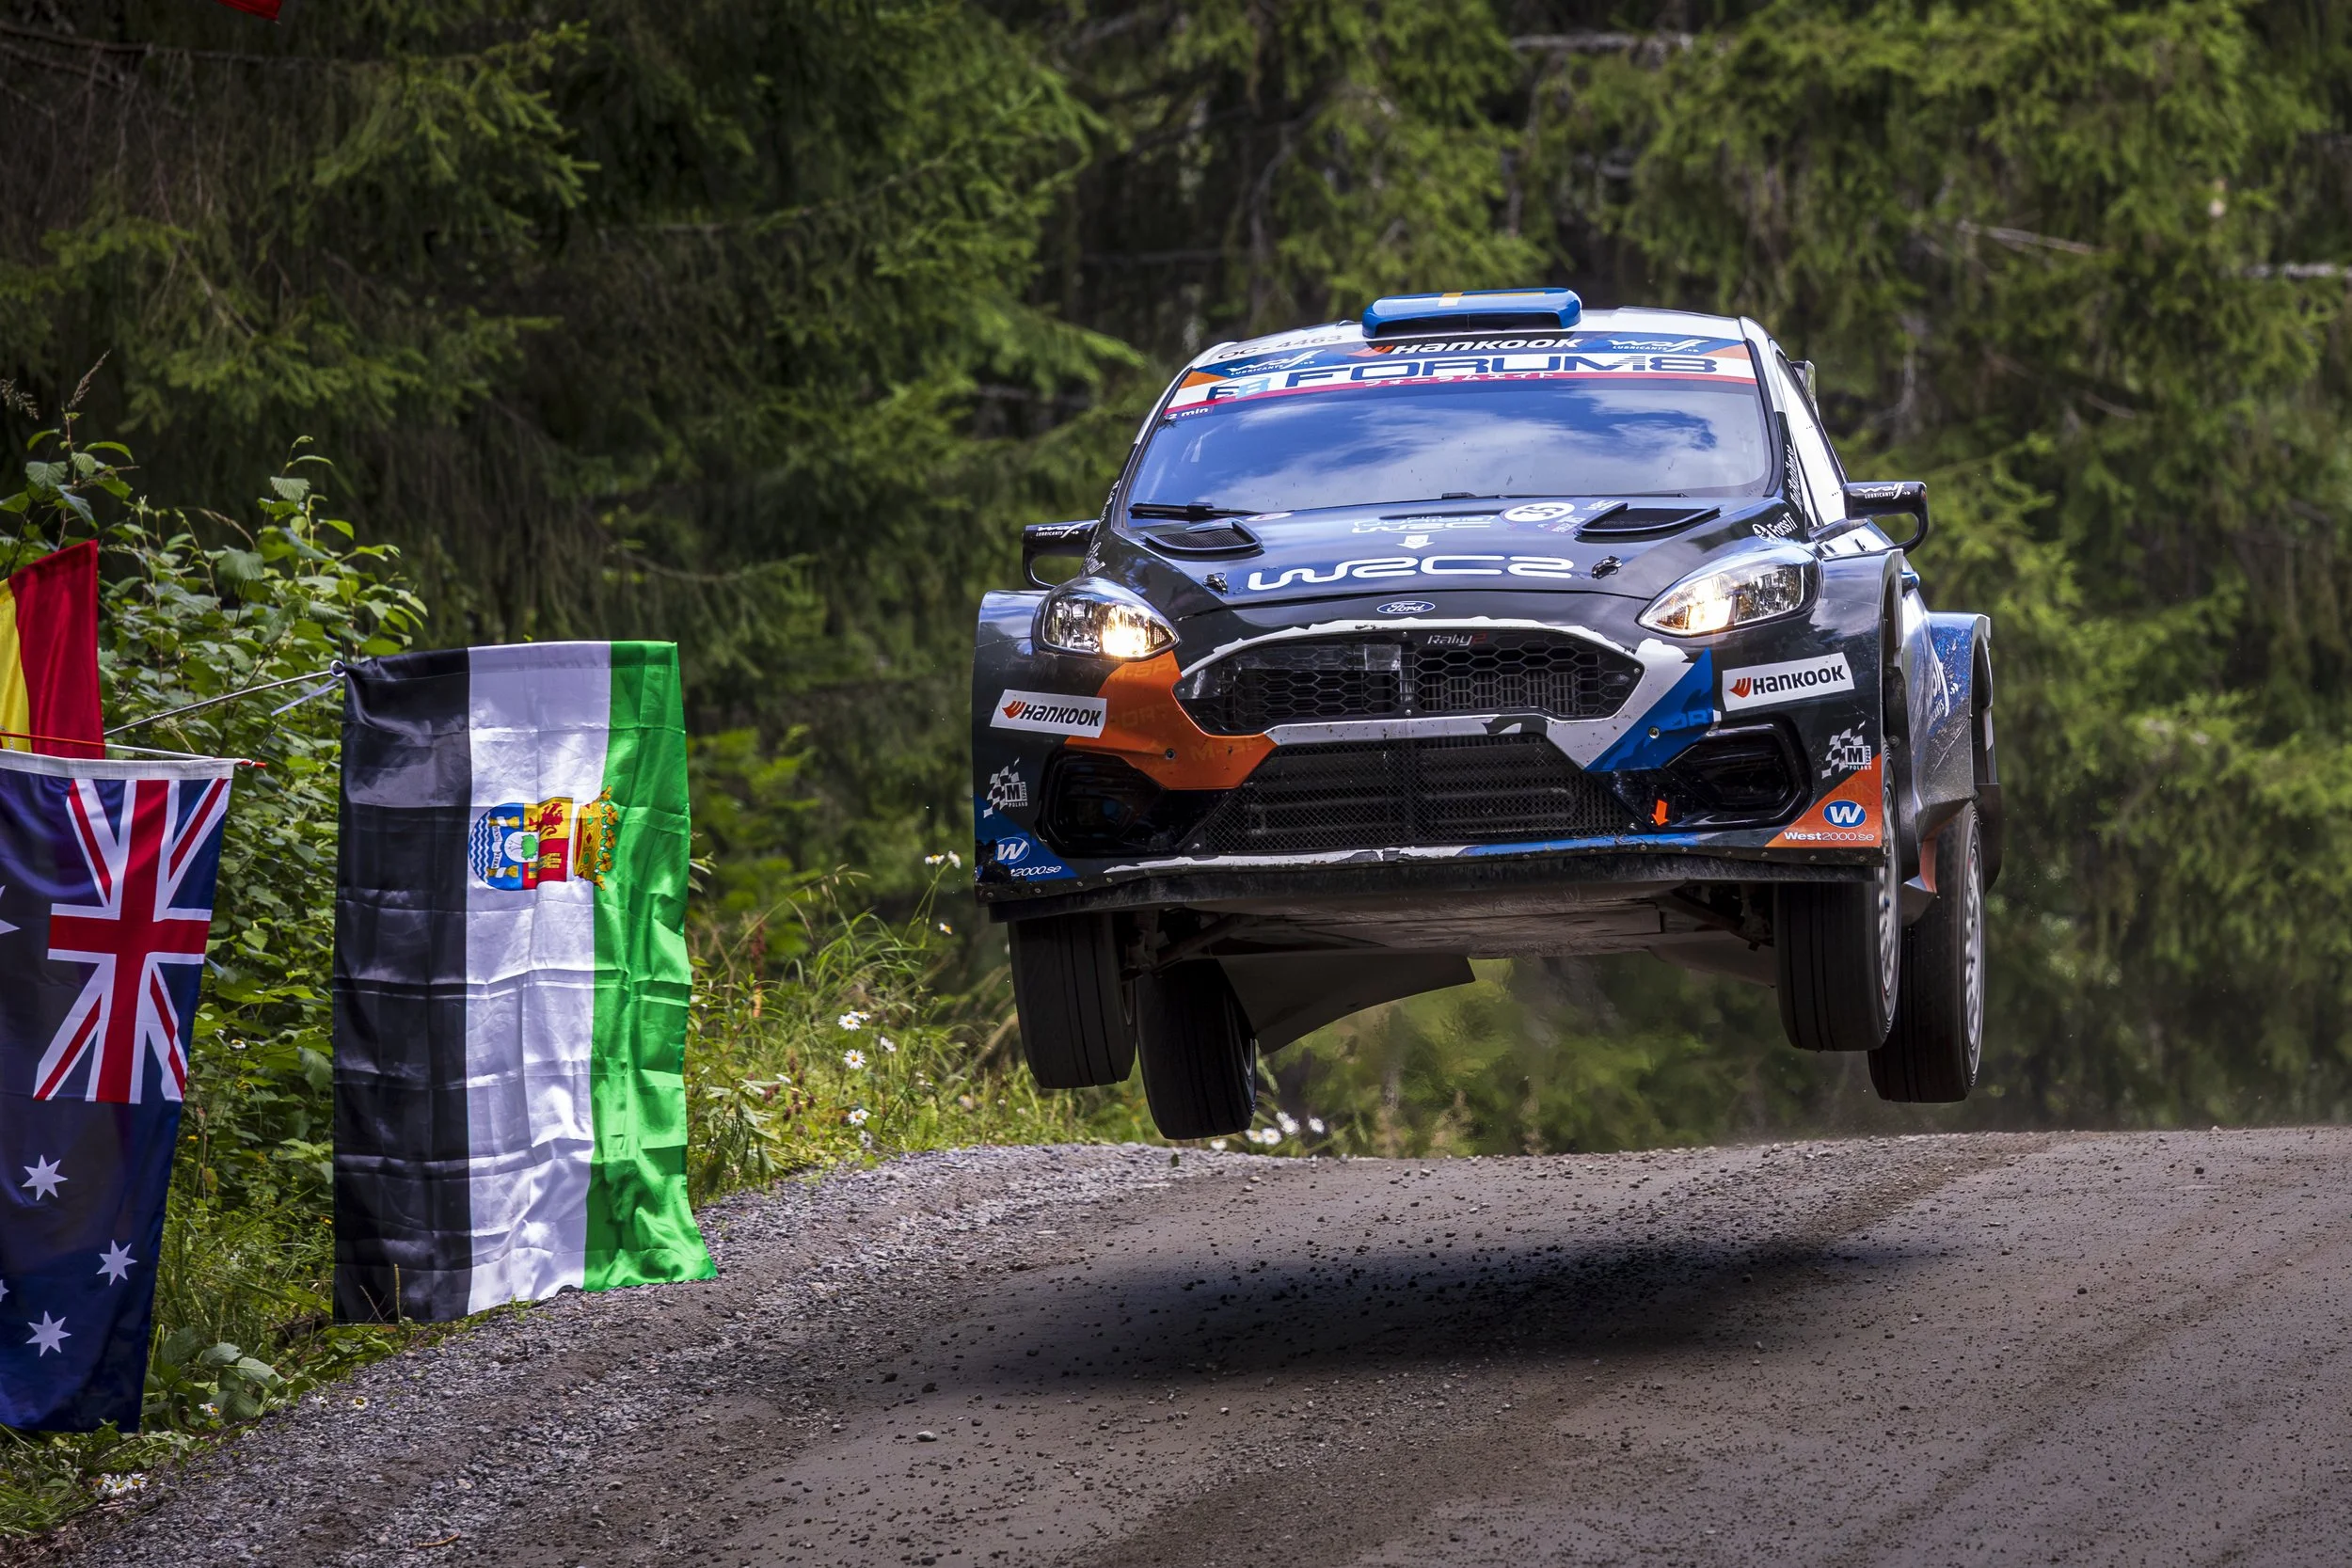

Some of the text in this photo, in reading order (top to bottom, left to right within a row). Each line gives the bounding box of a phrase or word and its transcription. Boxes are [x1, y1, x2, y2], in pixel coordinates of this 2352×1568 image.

[1285, 356, 1717, 388] FORUM8
[1182, 407, 1209, 417] min
[1248, 555, 1575, 591] WRC2
[1387, 602, 1424, 612] Ford
[1784, 832, 1874, 841] West2000.se
